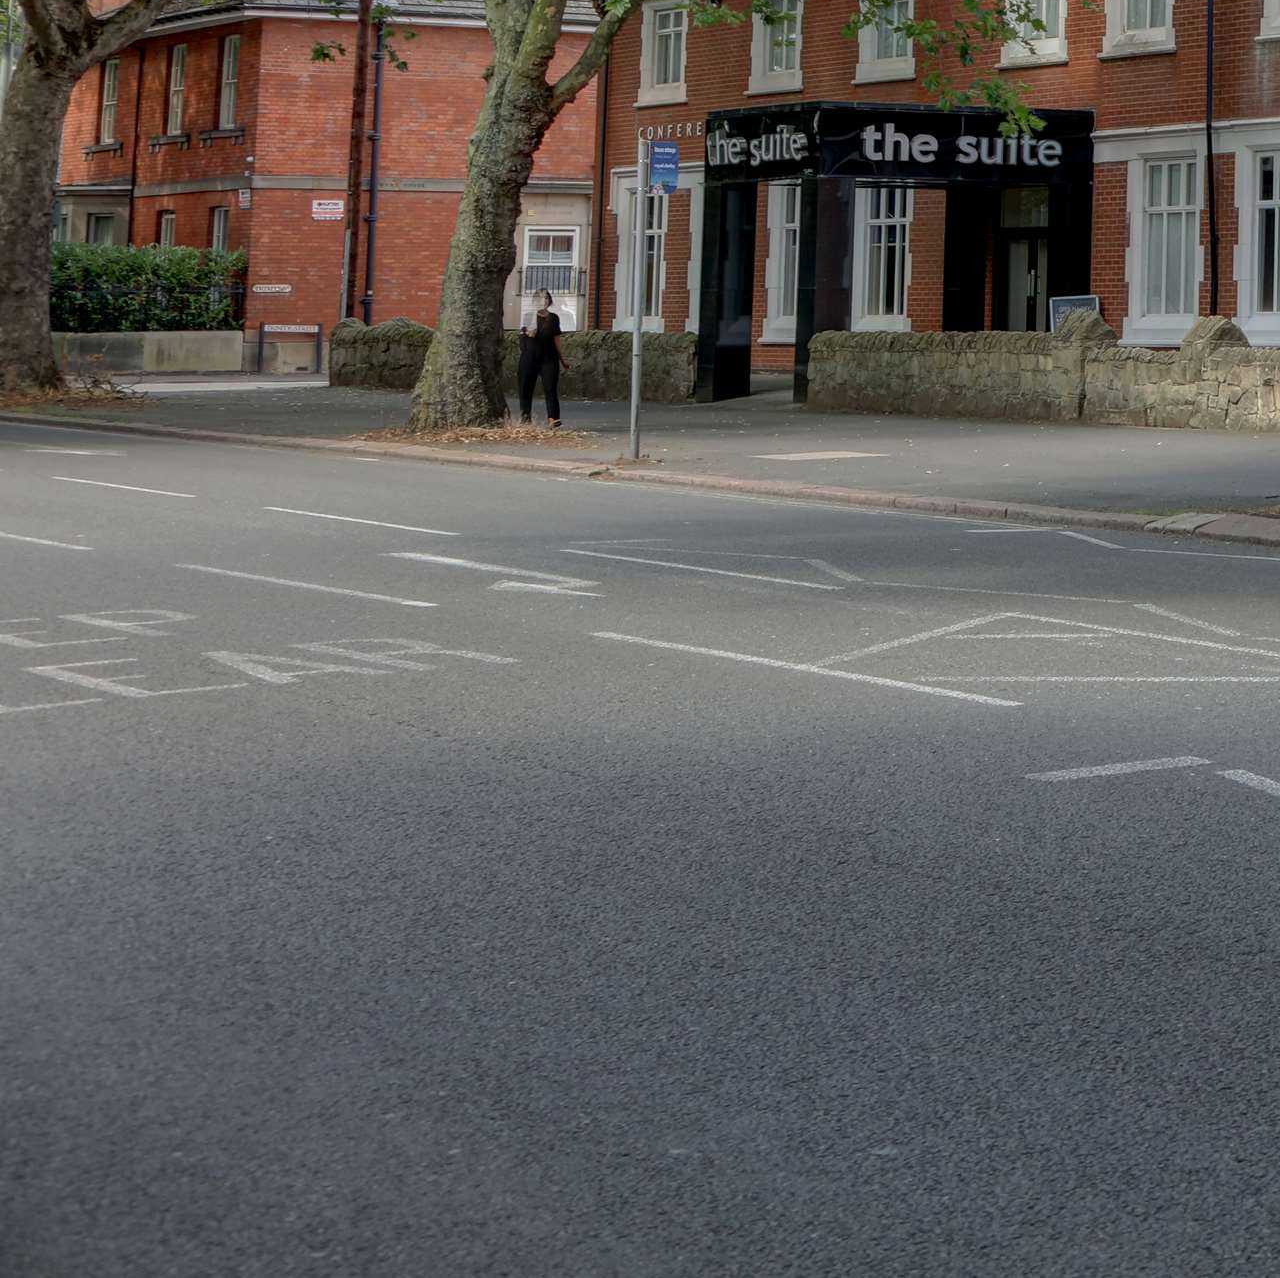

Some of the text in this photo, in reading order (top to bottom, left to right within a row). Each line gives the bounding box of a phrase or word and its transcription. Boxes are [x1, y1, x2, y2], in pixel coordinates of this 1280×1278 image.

[706, 125, 806, 167] the suite
[861, 123, 1063, 167] the suite
